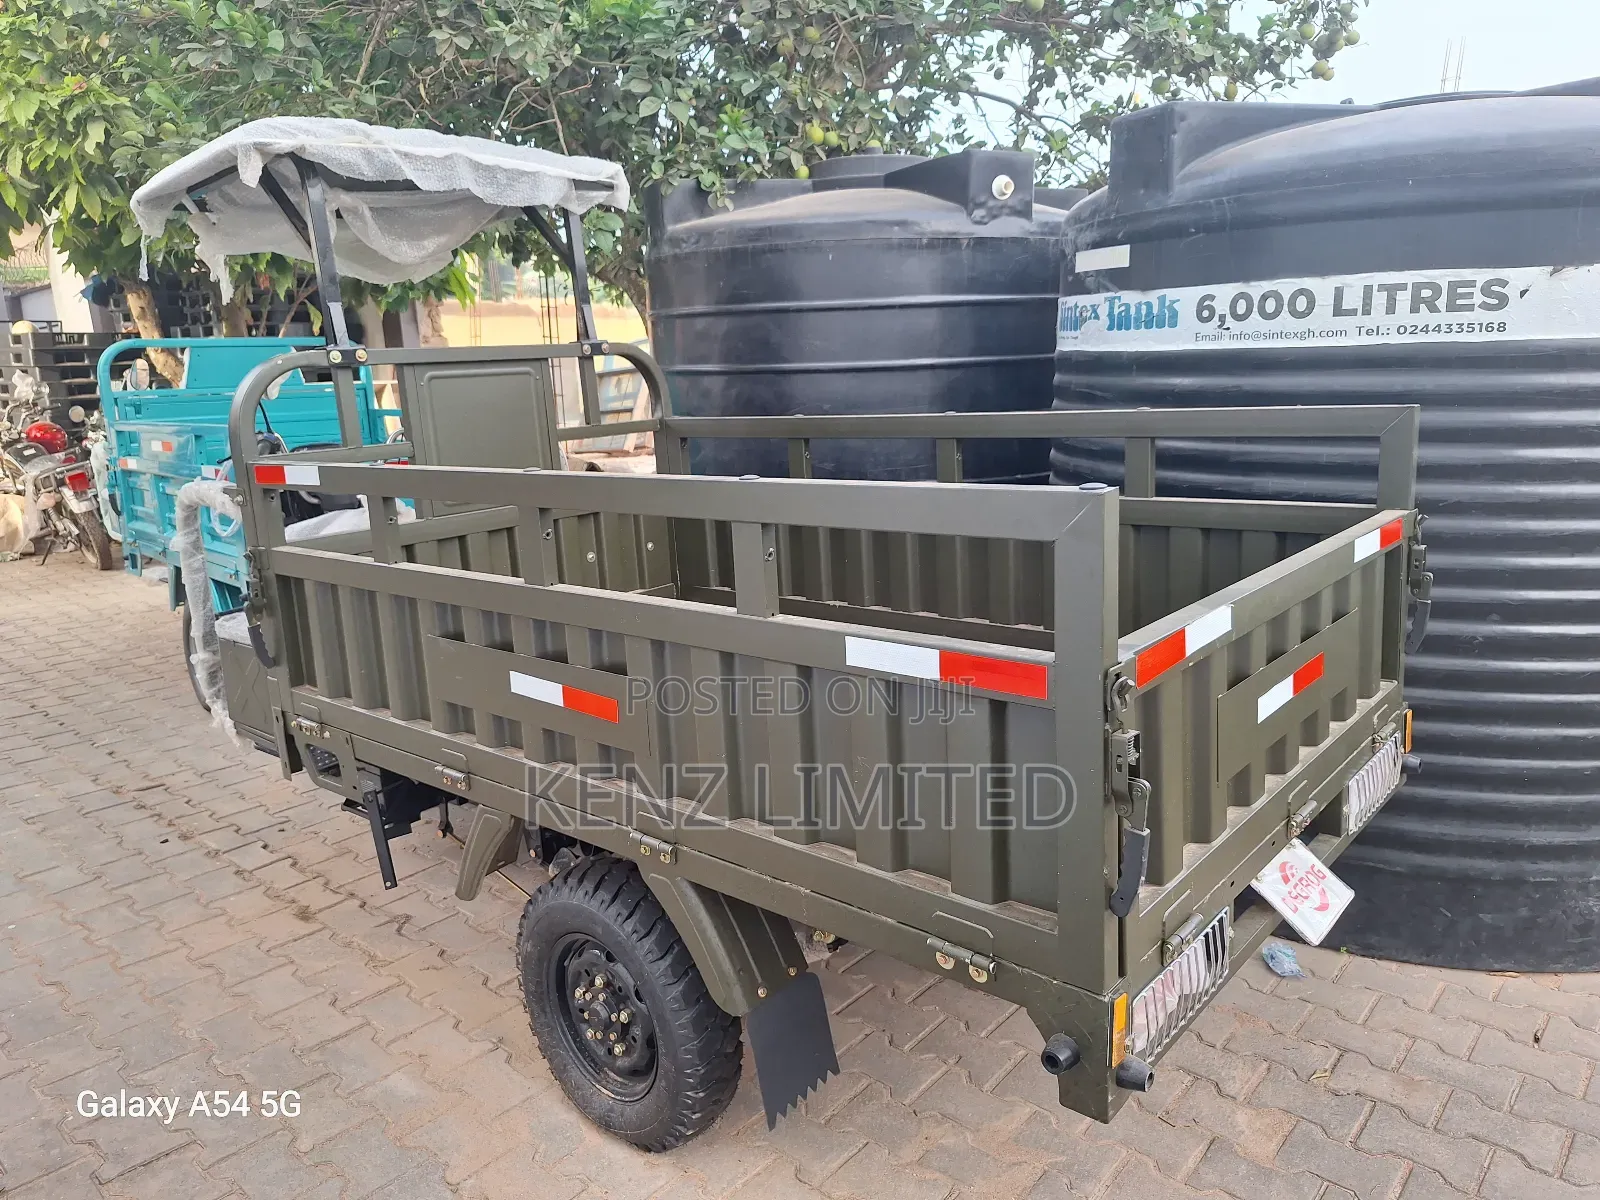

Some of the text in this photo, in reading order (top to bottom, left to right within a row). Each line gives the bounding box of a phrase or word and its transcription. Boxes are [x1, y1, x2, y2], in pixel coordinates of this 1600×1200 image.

[1104, 293, 1181, 331] Tank
[1195, 277, 1510, 331] 6,000 LITRES
[1195, 327, 1348, 342] Email: info@sintexgh.com
[1355, 321, 1507, 336] Tel.: 0244335168
